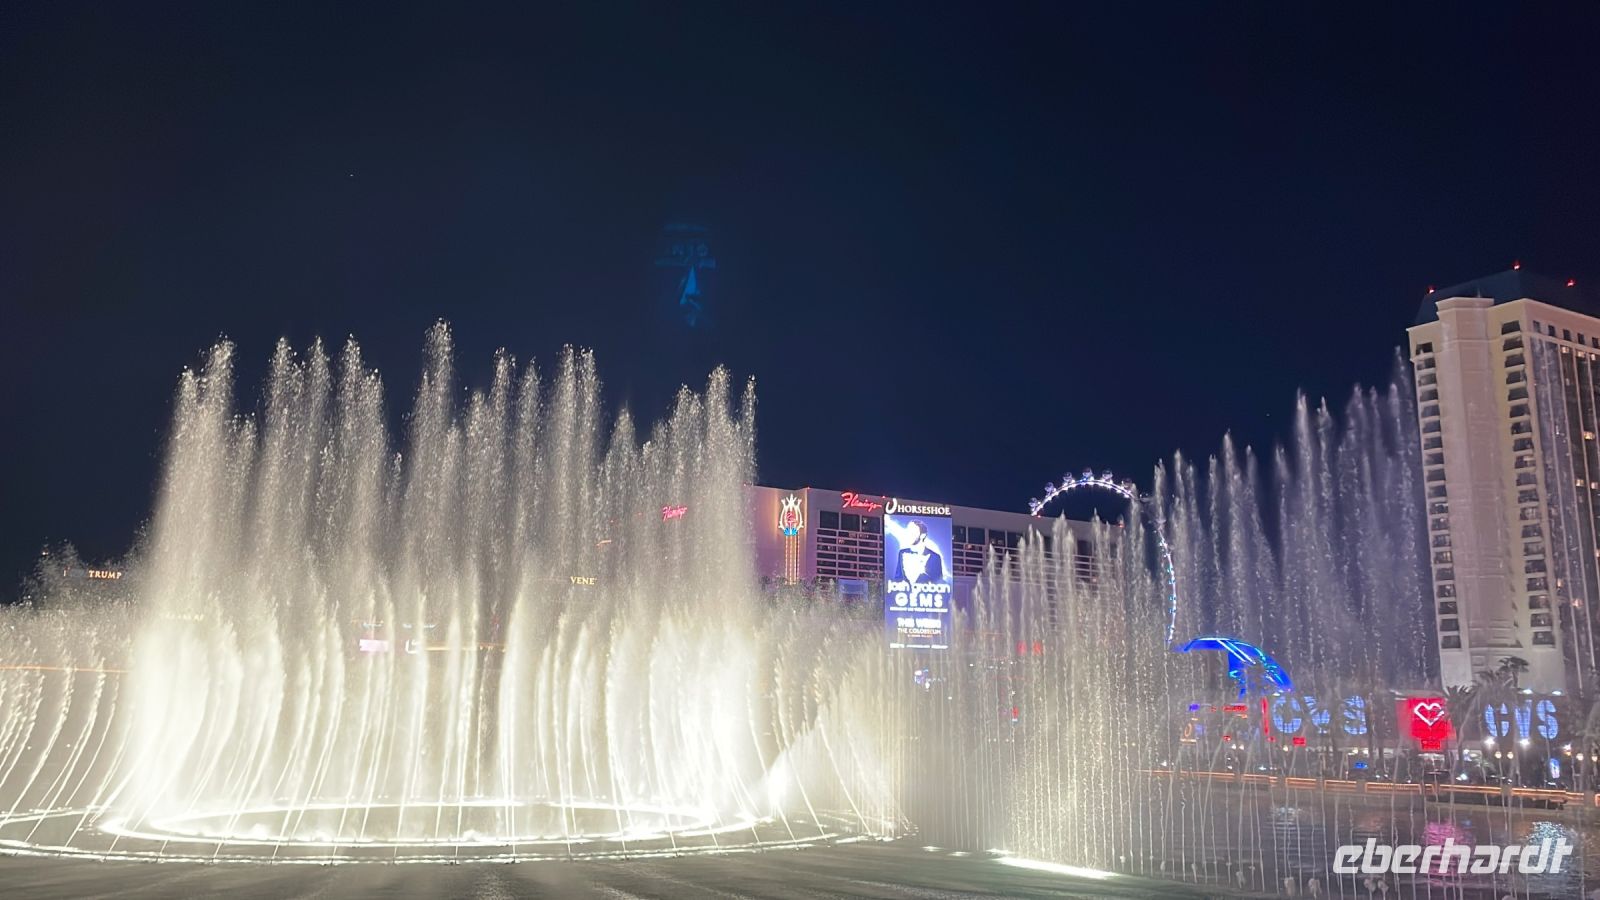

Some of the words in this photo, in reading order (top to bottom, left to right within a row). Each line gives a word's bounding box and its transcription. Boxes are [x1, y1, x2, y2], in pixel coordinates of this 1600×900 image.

[841, 492, 882, 512] Flamingo
[897, 504, 951, 515] HORSESHOE
[88, 569, 122, 579] TRUMP
[570, 577, 598, 585] VENE
[895, 592, 943, 607] GEMS
[1272, 695, 1366, 735] CVS
[1485, 699, 1560, 740] CVS
